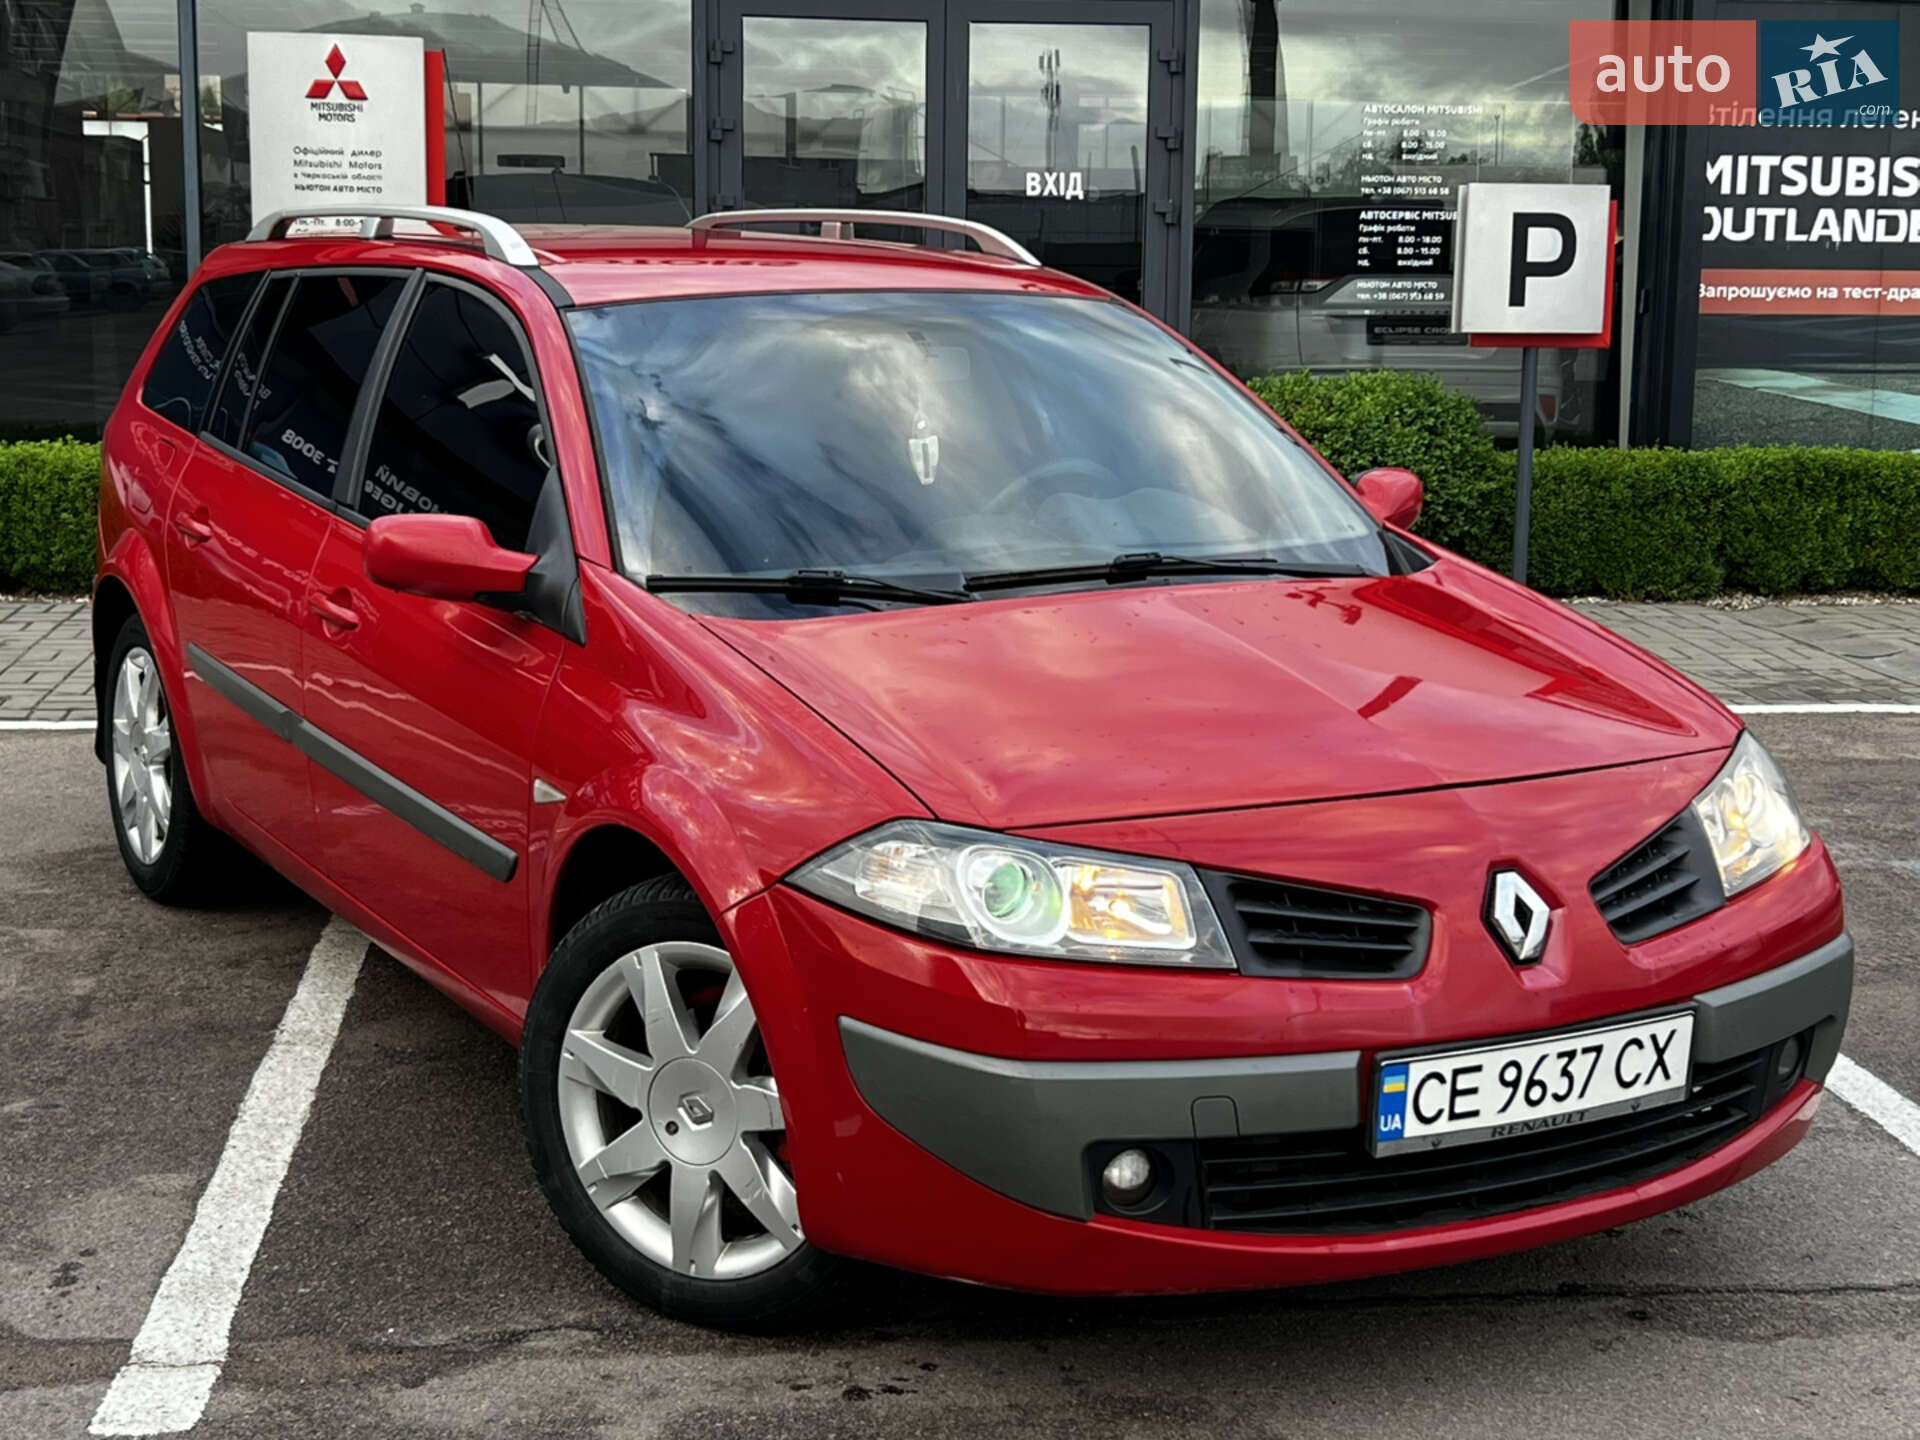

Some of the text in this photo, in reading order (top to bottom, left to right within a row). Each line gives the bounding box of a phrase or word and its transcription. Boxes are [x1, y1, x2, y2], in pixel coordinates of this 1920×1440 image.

[310, 102, 363, 112] MITSUBISHI
[1363, 104, 1483, 115] АВТОСАЛОН MITSUBISHI
[318, 113, 356, 122] MOTORS
[293, 160, 382, 170] Mitsubishi Motors
[356, 186, 383, 194] МІСТО
[1026, 172, 1084, 200] ВХІД
[1359, 210, 1420, 220] АВТОСЕРВІС
[1359, 224, 1416, 233] Графік роботи
[1509, 212, 1577, 307] P
[1698, 283, 1812, 302] Запрошуємо
[1816, 286, 1838, 298] на
[1412, 1028, 1678, 1125] CE 9637 CX
[1380, 1114, 1402, 1132] UA
[1490, 1111, 1590, 1138] RENAULT
